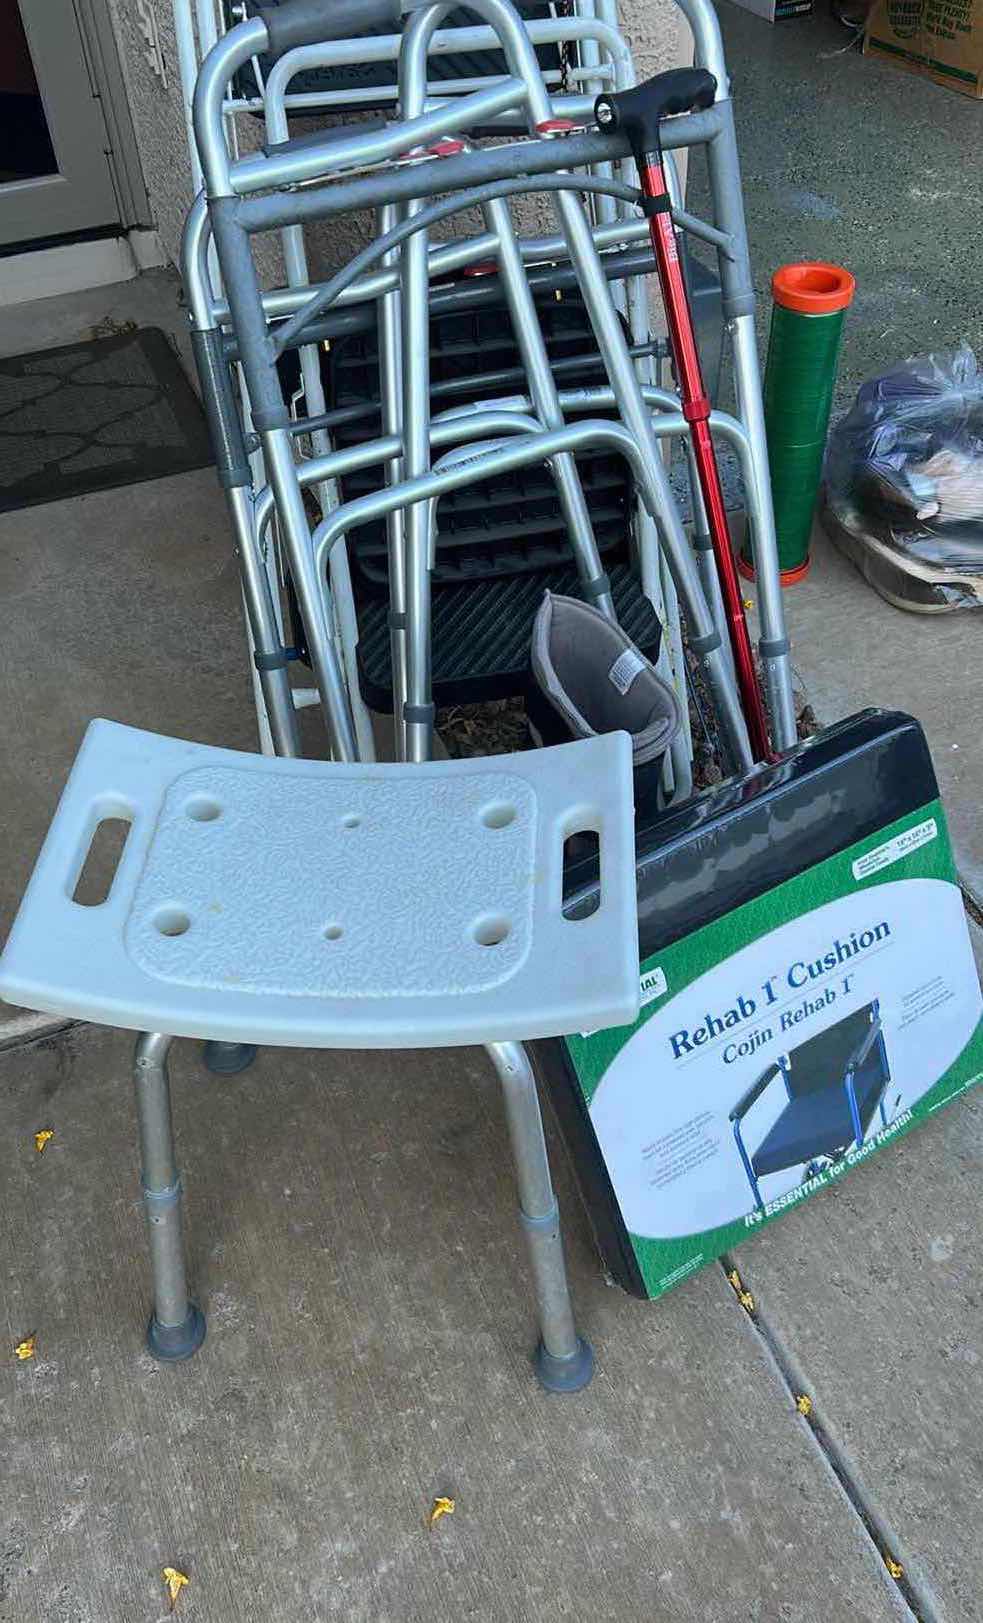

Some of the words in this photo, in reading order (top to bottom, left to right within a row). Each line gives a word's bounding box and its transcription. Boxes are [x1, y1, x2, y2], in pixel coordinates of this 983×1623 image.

[668, 995, 757, 1060] Rehab
[787, 921, 892, 988] Cushion
[722, 1027, 774, 1064] Cojin
[779, 988, 836, 1033] Rehab
[765, 1171, 828, 1217] ESSENTIAL
[828, 1161, 846, 1178] for
[847, 1141, 877, 1165] Good
[877, 1109, 914, 1144] Health!
